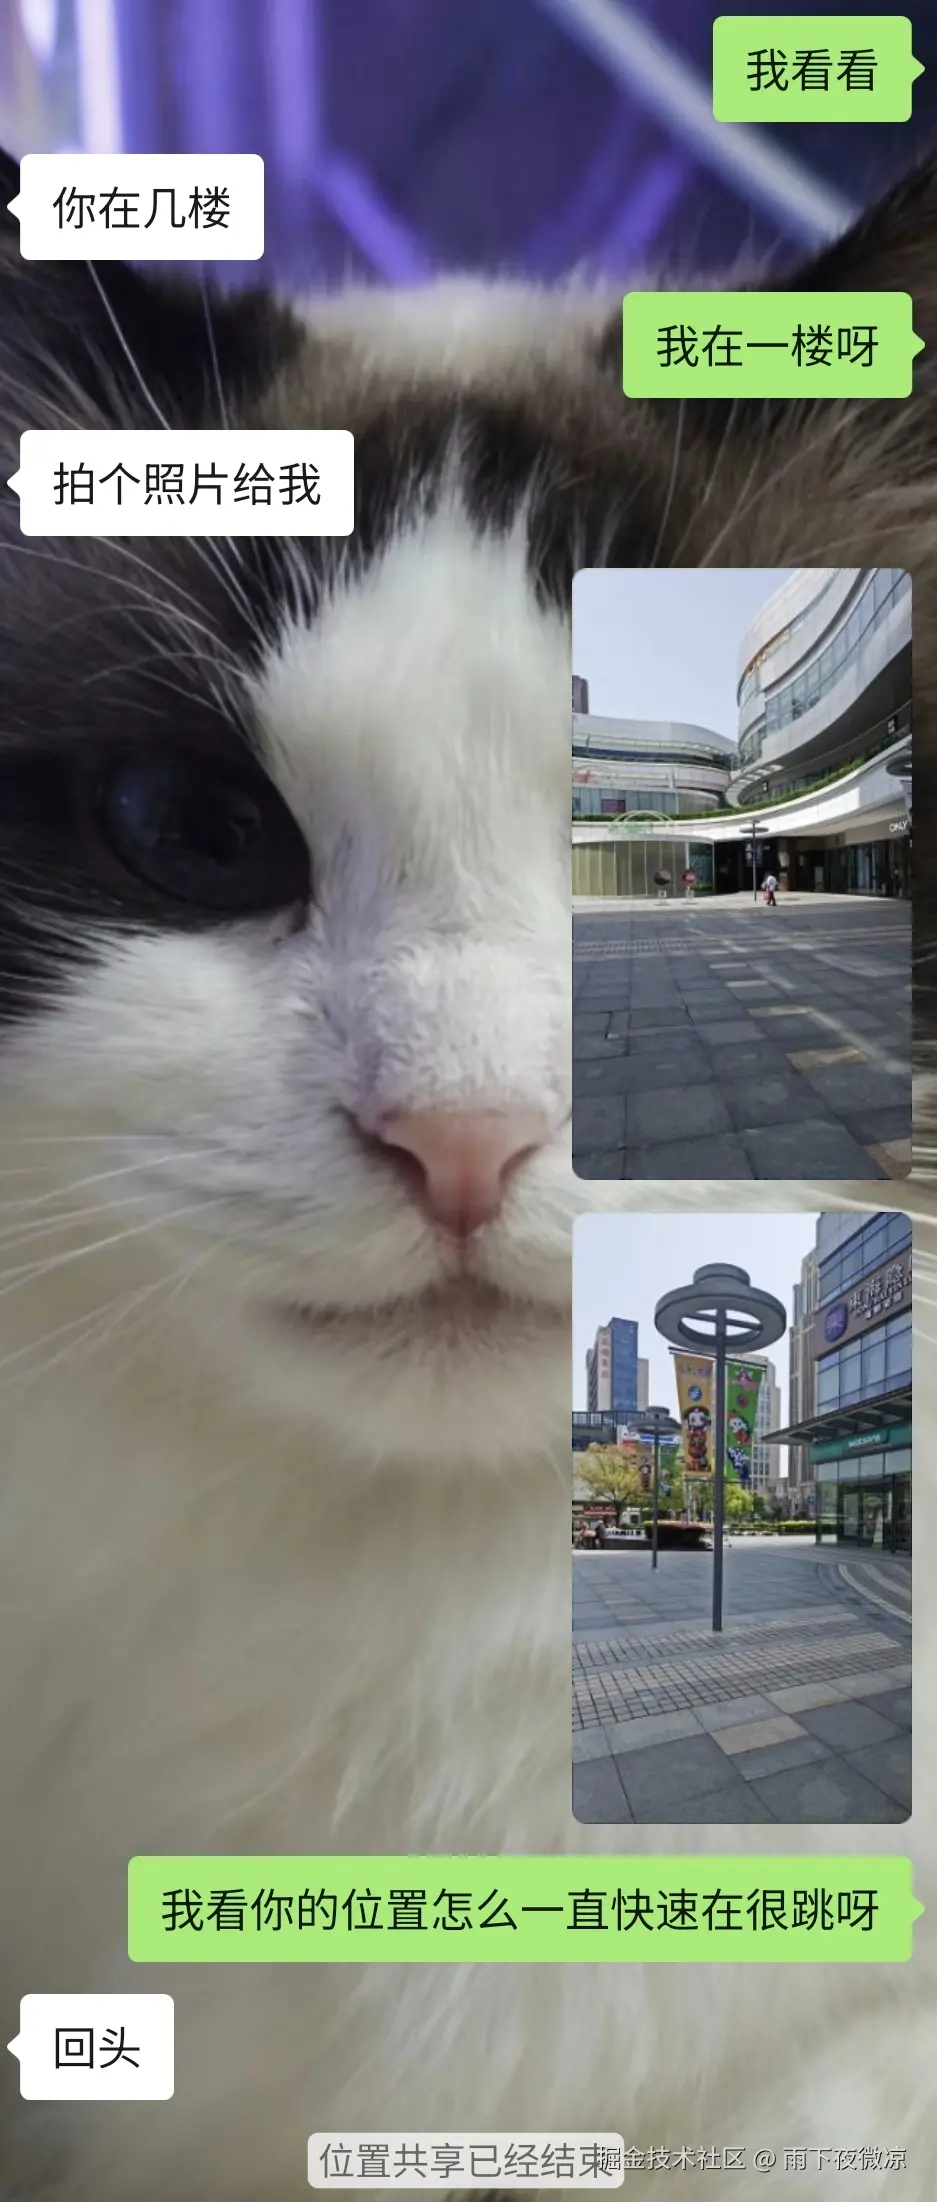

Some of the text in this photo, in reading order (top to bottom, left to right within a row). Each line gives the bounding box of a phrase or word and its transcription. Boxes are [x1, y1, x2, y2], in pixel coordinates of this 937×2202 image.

[746, 48, 878, 92] 我看看
[52, 185, 231, 229] 你在几楼
[656, 323, 879, 368] 我在一楼呀
[53, 462, 321, 506] 拍个照片给我
[161, 1887, 879, 1932] 我看你的位置怎么一直快速在很跳呀
[55, 2026, 140, 2069] 回头
[319, 2142, 614, 2179] 位置共享已经结束
